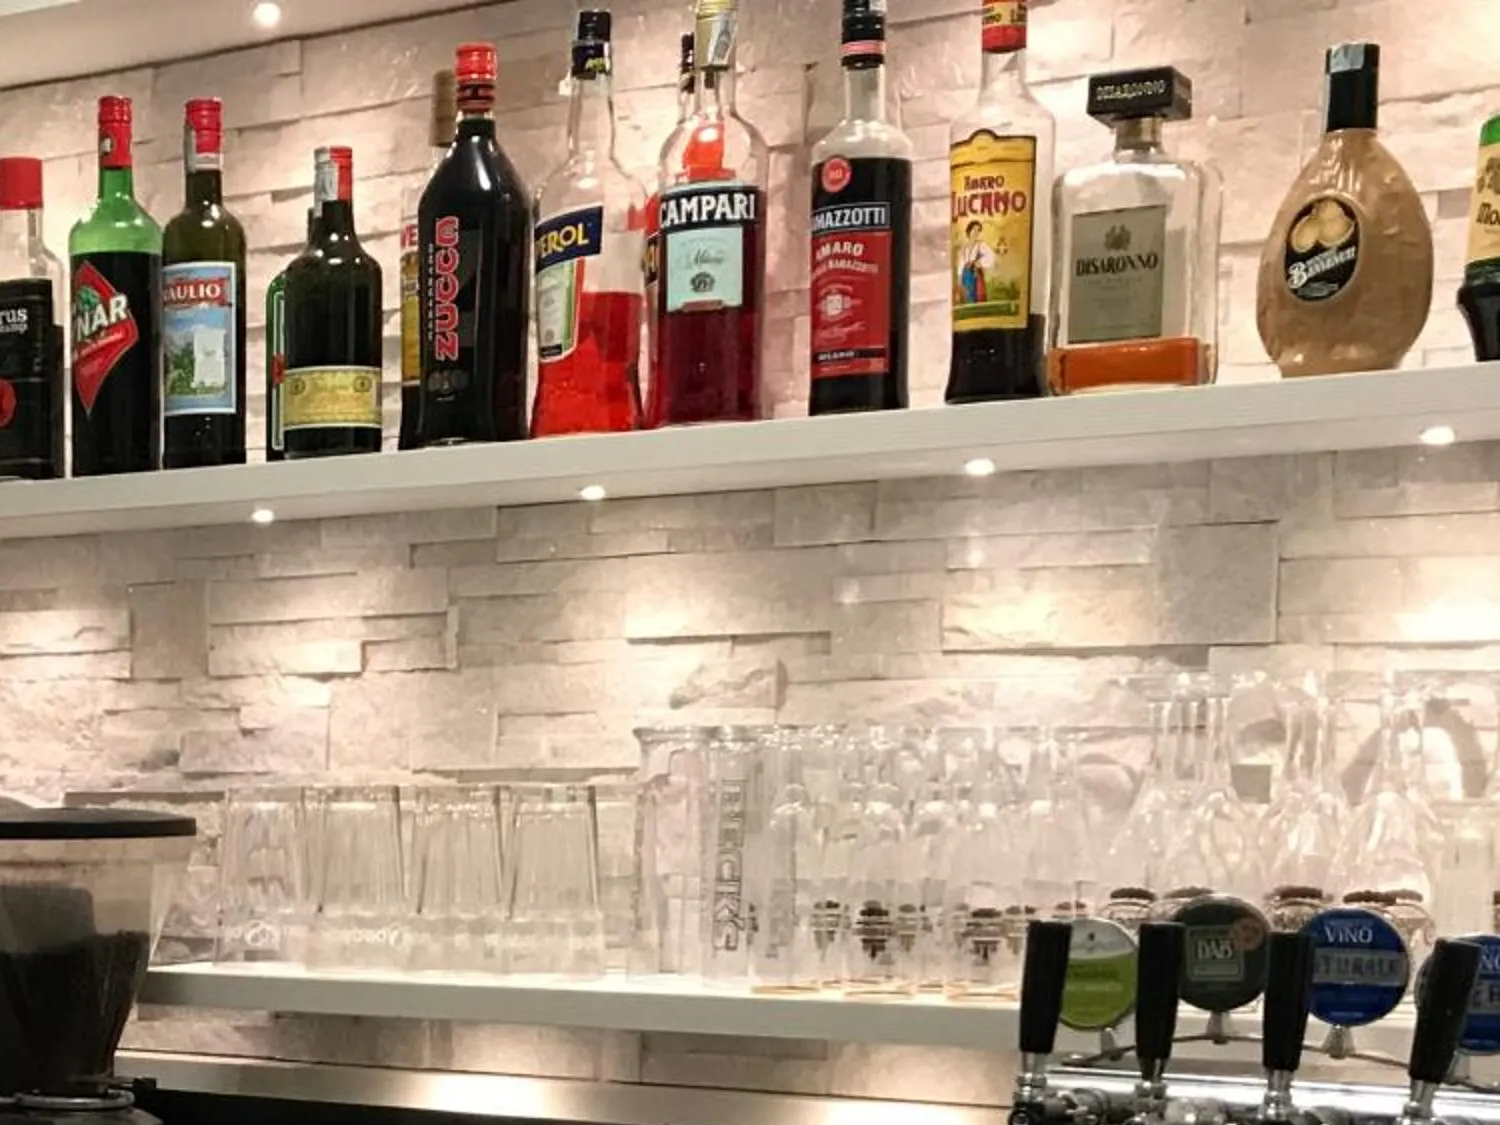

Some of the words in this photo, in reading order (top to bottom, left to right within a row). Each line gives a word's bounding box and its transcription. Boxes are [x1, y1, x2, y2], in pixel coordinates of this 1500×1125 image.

[660, 192, 756, 229] CAMPARI
[814, 207, 886, 229] MAZZOTTI
[951, 191, 1027, 222] LUCANO
[538, 222, 591, 259] EROL
[1076, 252, 1159, 277] DISARONNO
[75, 293, 128, 342] NAR
[1325, 926, 1373, 944] VINO
[1312, 954, 1398, 977] TURALE
